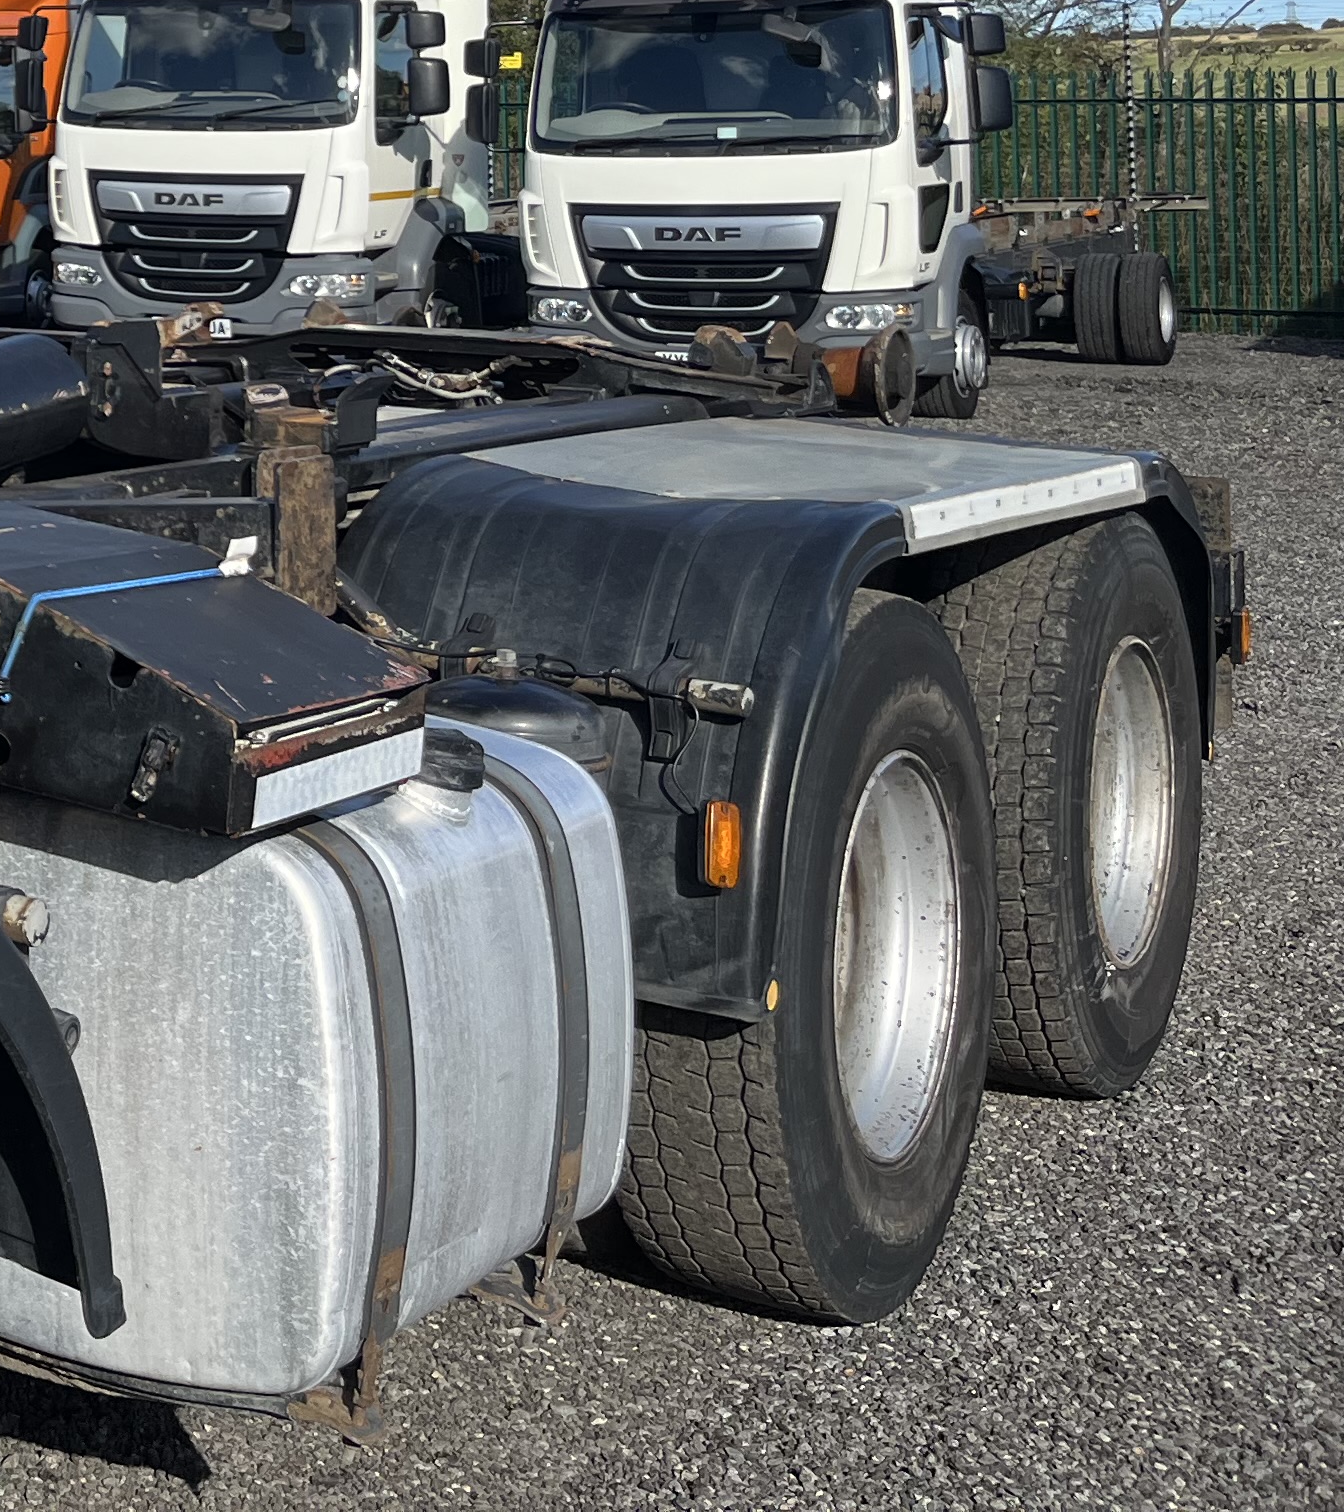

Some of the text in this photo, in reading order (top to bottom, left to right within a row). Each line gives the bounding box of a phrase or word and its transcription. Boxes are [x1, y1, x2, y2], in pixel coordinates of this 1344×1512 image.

[154, 192, 224, 207] DAF
[374, 230, 387, 239] LF
[654, 226, 741, 242] DAF
[919, 262, 930, 273] LF
